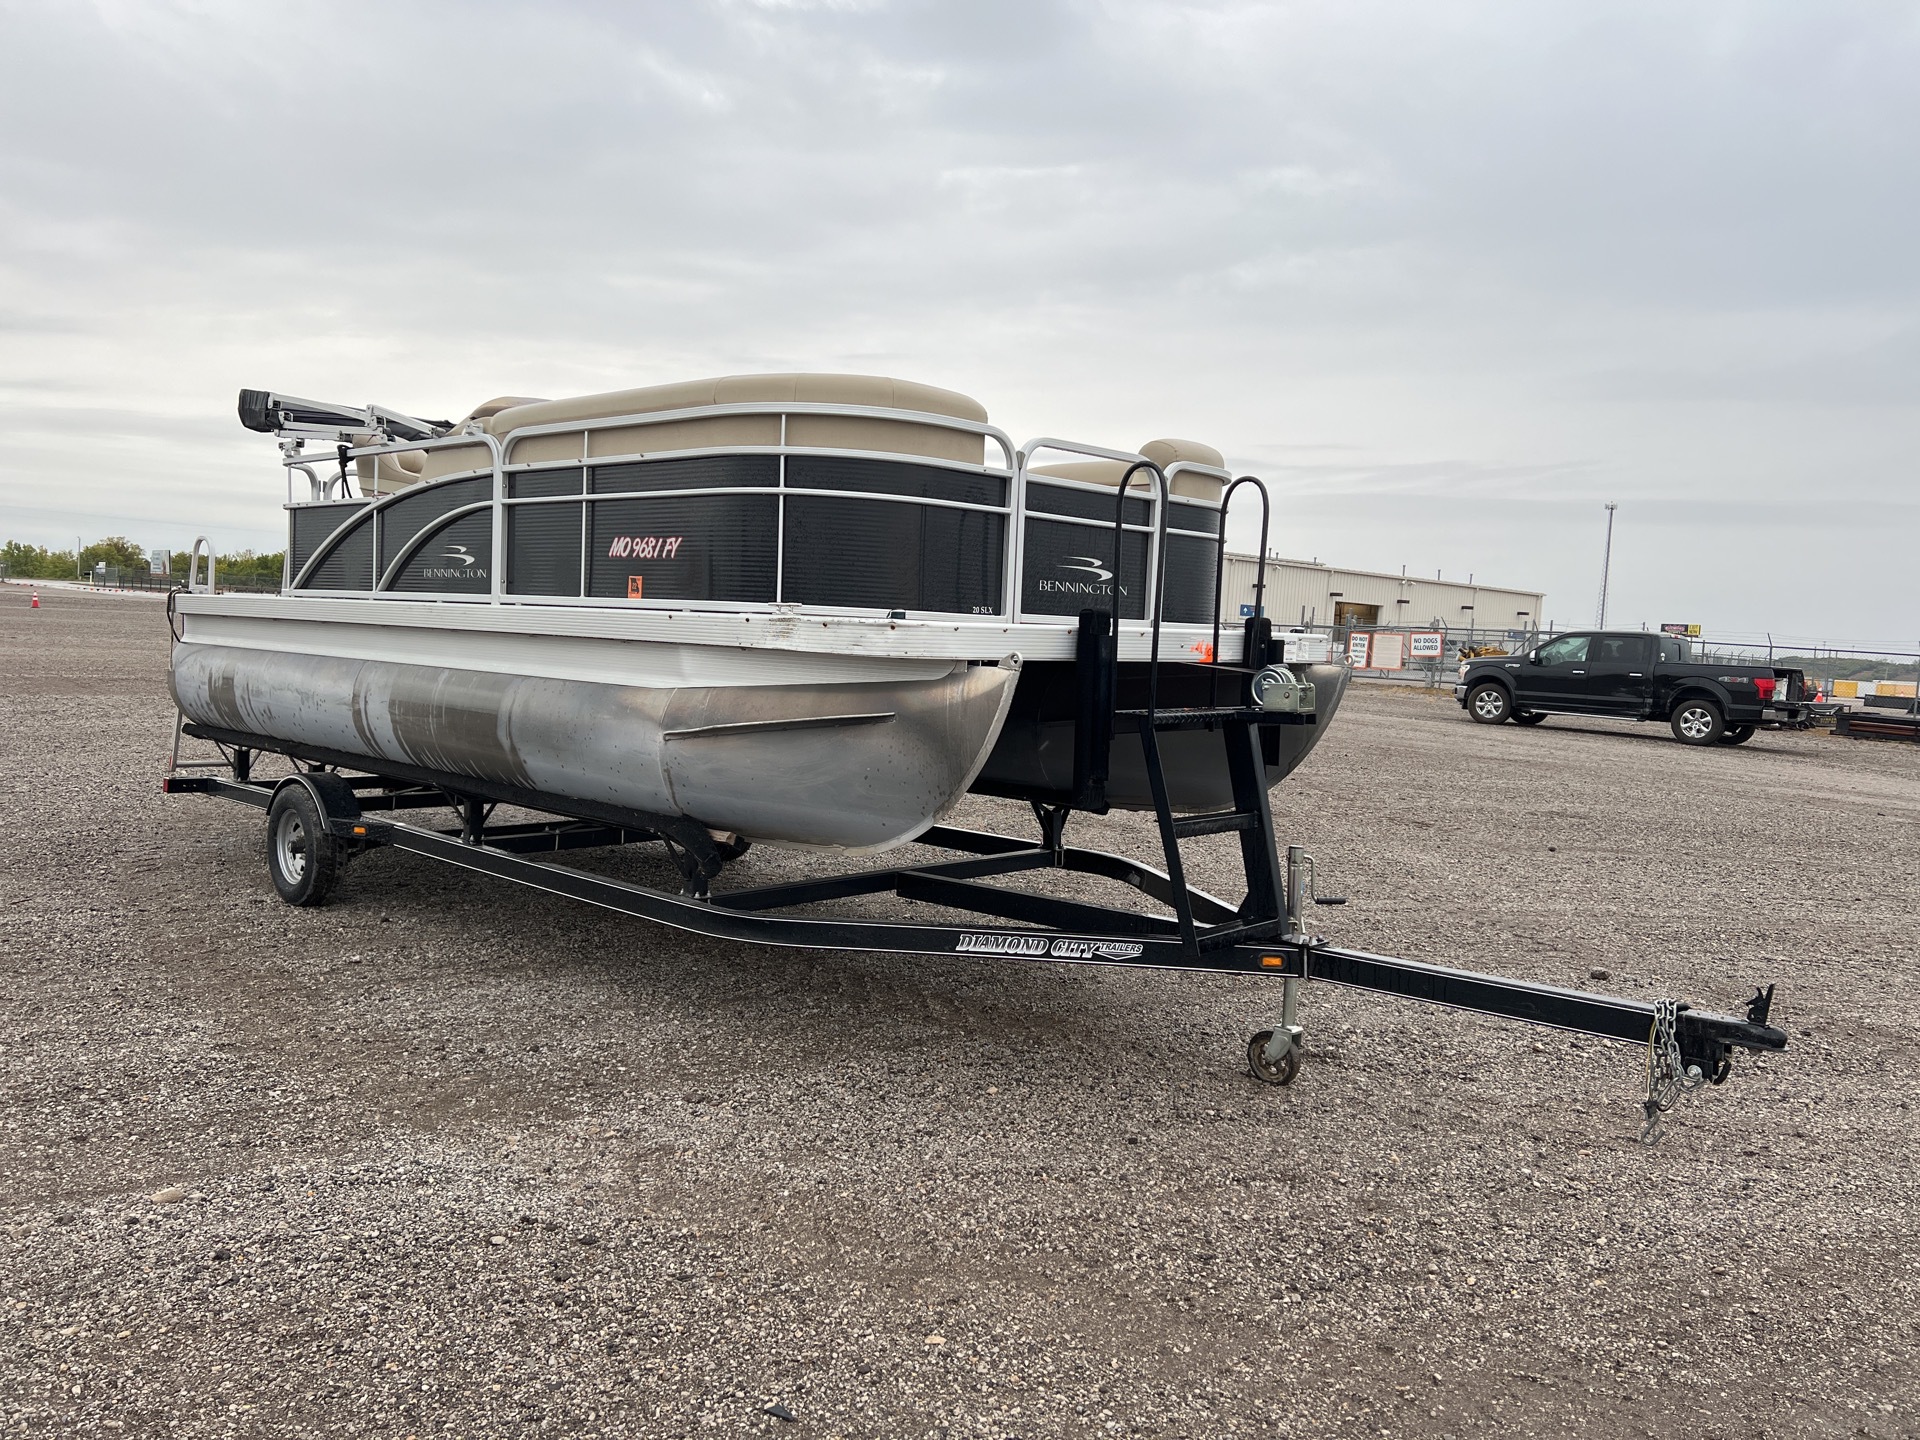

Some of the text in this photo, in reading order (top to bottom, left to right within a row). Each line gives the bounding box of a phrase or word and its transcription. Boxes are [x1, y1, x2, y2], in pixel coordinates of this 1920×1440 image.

[608, 536, 683, 559] MO 9681 FY
[423, 568, 487, 578] BENNINGTON
[972, 606, 993, 615] 20 SLX
[955, 934, 1144, 958] DIAMOND CITY TRAILERS
